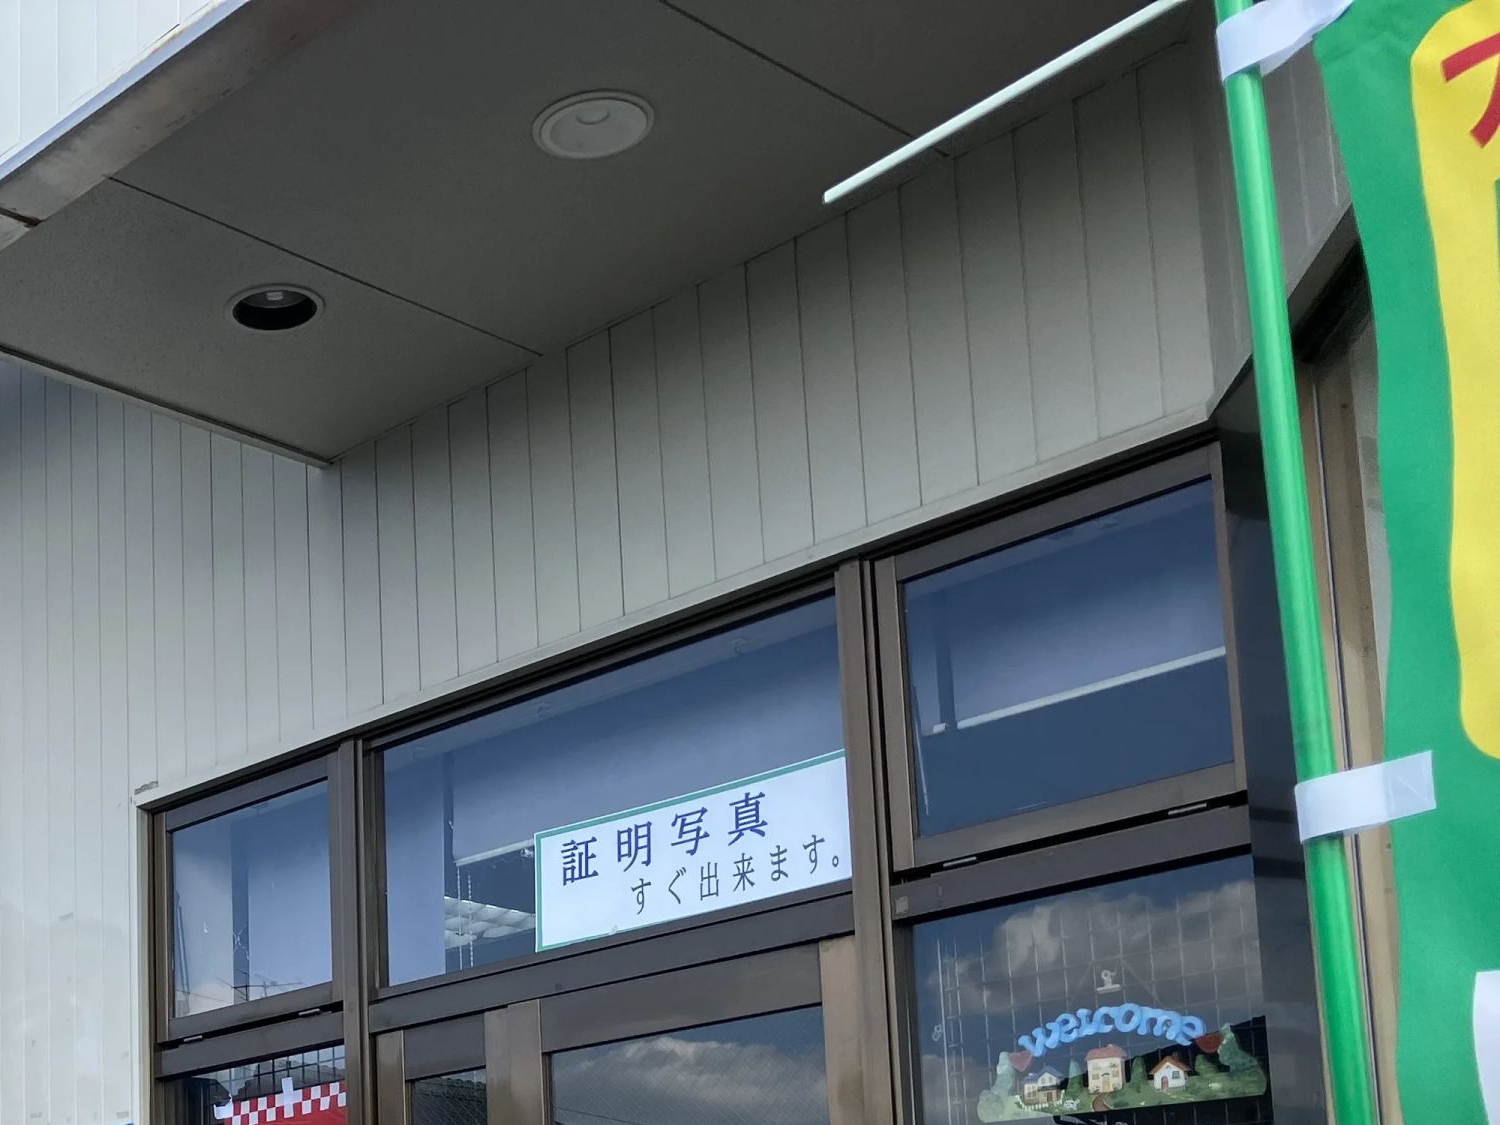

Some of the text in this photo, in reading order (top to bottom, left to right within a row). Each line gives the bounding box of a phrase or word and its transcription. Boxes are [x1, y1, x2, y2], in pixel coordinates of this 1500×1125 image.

[561, 791, 768, 886] 証明写真
[630, 834, 840, 915] すぐ出来ます。
